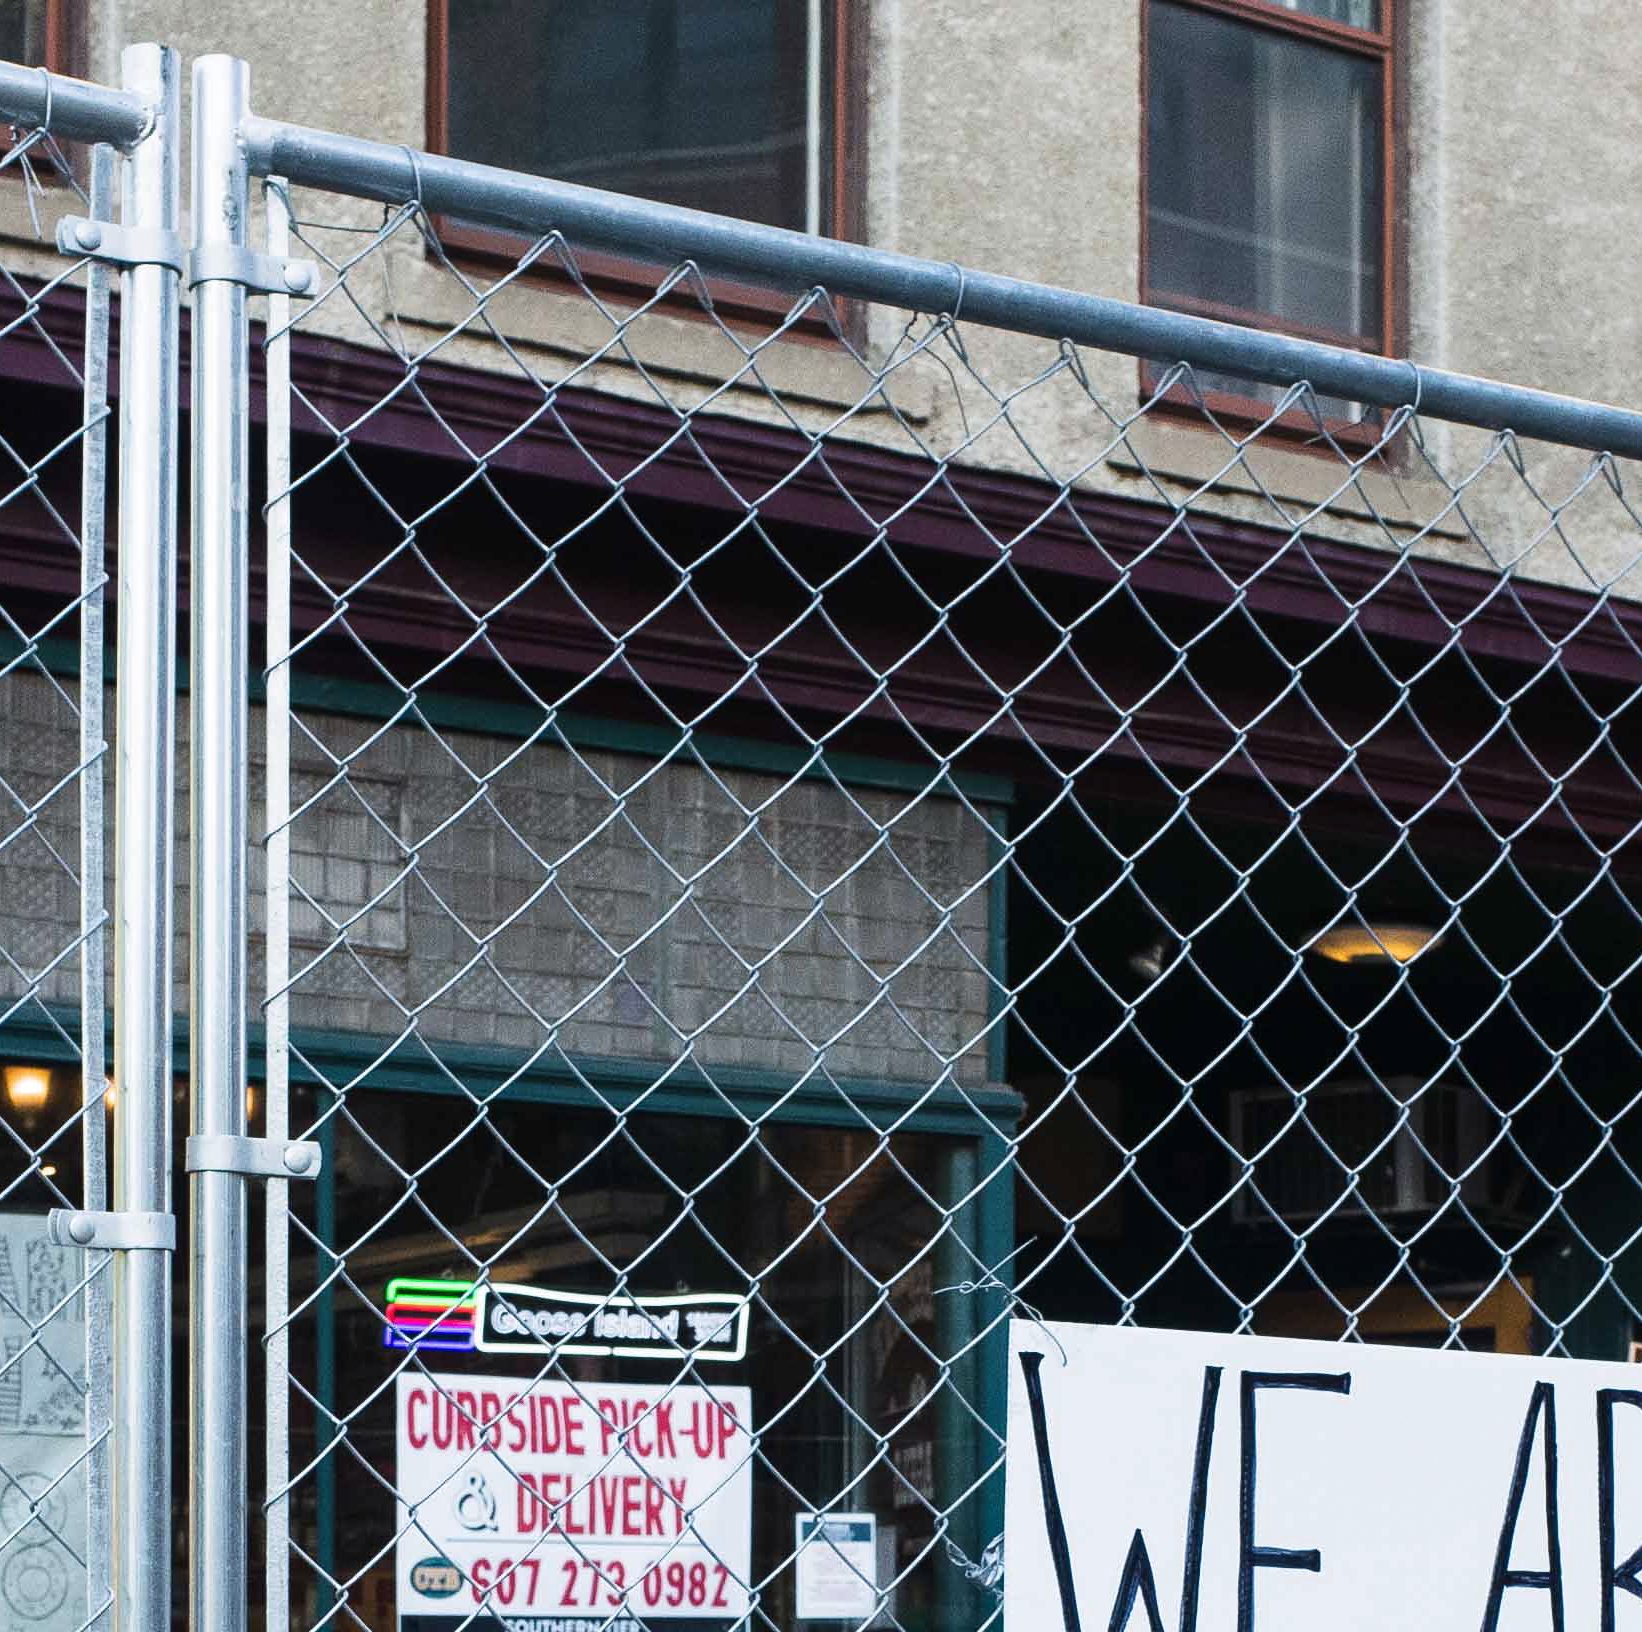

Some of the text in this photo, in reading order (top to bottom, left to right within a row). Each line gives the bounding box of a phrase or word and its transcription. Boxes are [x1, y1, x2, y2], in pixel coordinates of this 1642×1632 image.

[407, 1389, 739, 1459] CURBSIDE PICK-UP
[516, 1473, 688, 1538] DELIVERY
[471, 1558, 541, 1607] 607
[560, 1559, 626, 1607] 273
[643, 1561, 729, 1608] 0982
